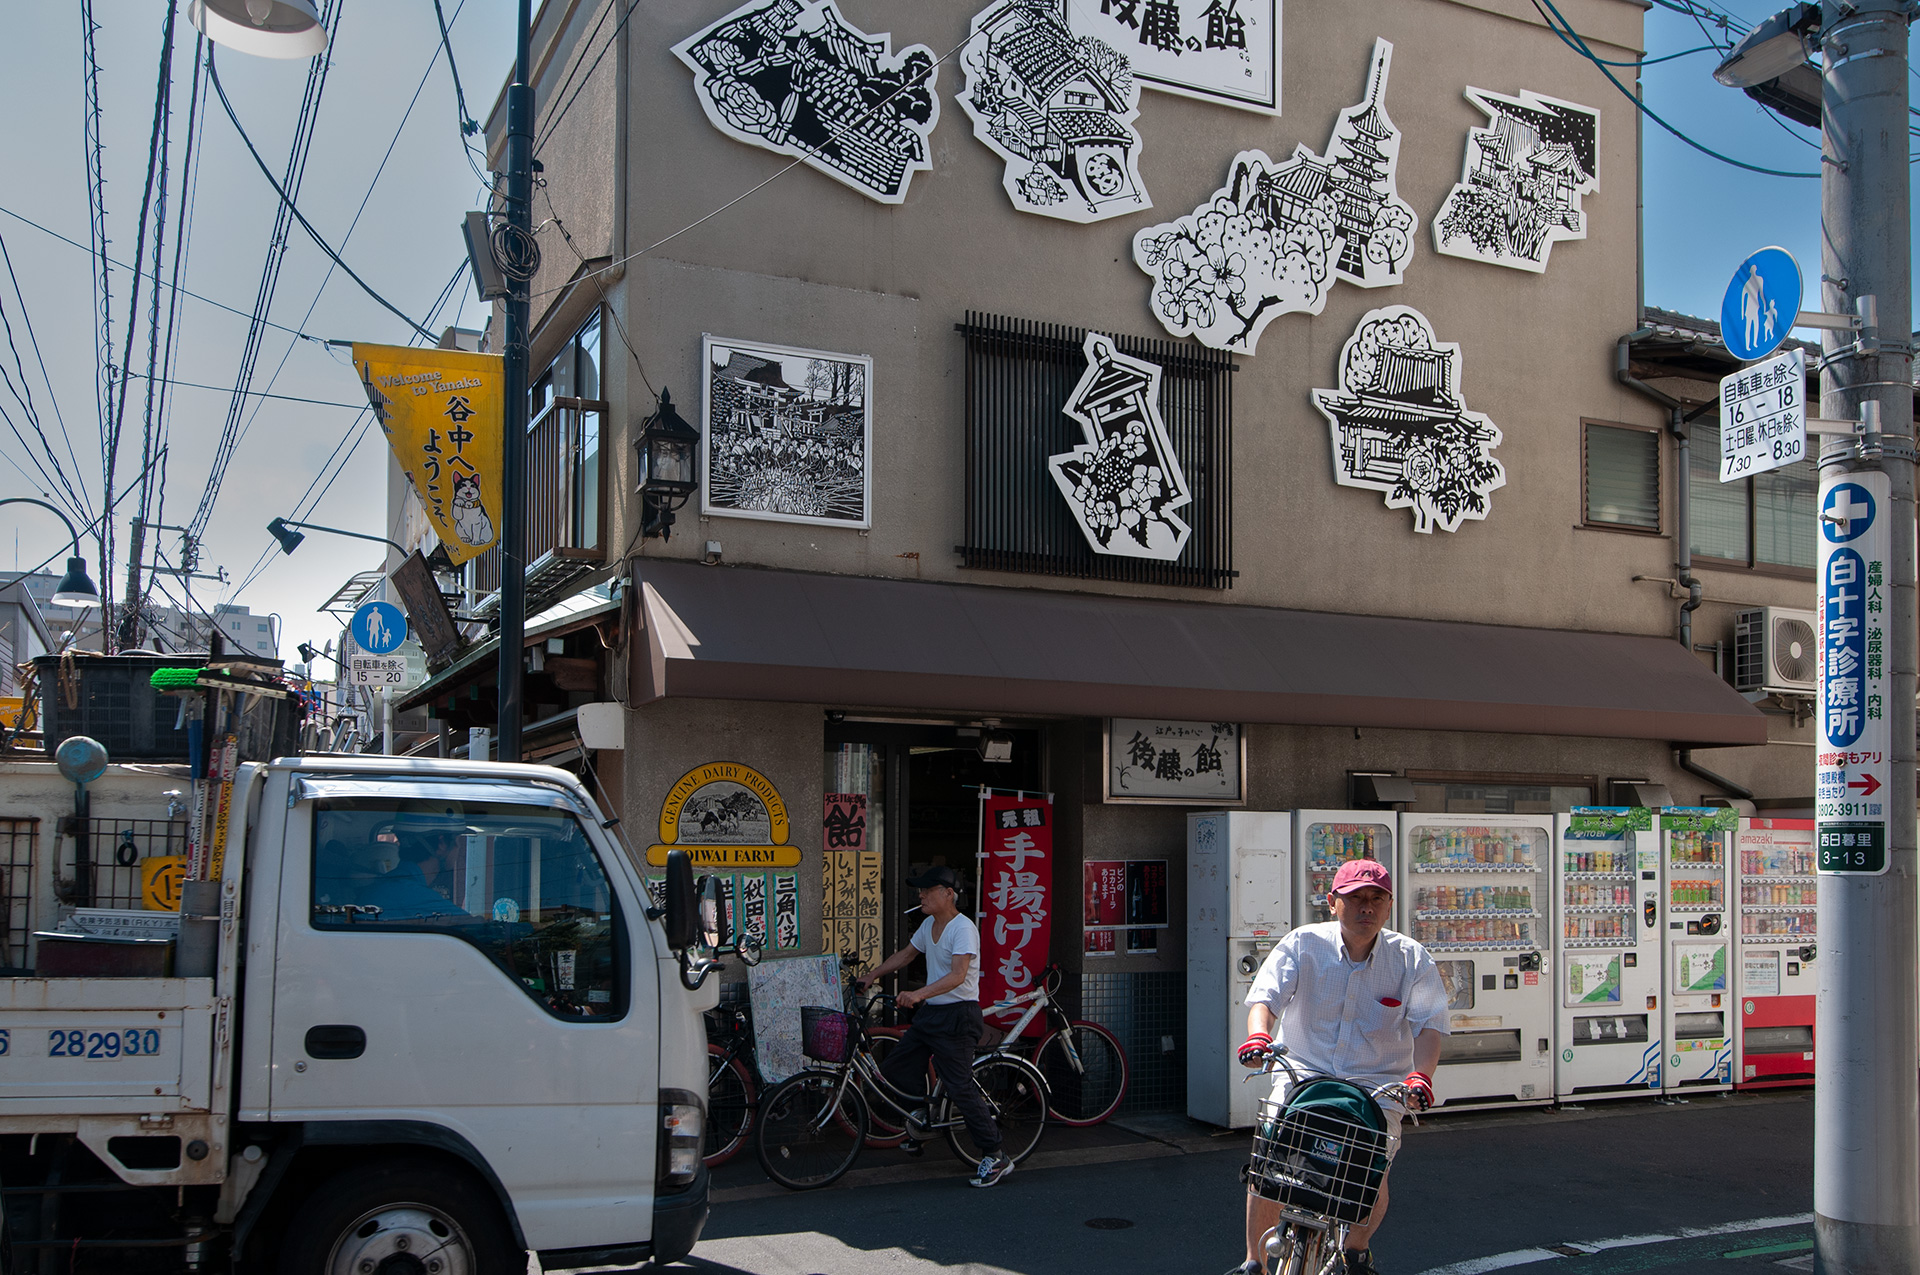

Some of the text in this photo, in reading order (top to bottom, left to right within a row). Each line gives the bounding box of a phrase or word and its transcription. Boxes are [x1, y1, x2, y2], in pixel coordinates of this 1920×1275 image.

[377, 370, 442, 388] Welcome
[411, 376, 482, 396] to Yanaka
[1725, 361, 1799, 403] 自転車を除く
[1729, 403, 1745, 426] 16
[1777, 385, 1794, 409] 18
[443, 395, 476, 472] 谷中へ
[1725, 454, 1752, 475] 7.30
[1772, 439, 1801, 461] 8.30
[422, 427, 449, 528] ようこそ
[1828, 555, 1860, 736] 白十字診療所
[353, 659, 404, 671] 自転車を除く
[356, 671, 368, 682] 15
[386, 671, 402, 683] 20
[1126, 730, 1222, 782] 後藤の飴
[664, 765, 786, 827] GENUINE DAIRY PRODUCTS
[823, 803, 866, 849] 飴
[1002, 809, 1041, 828] 元祖
[1334, 823, 1360, 833] KIRIN
[1466, 826, 1491, 836] KIRIN
[1740, 833, 1774, 845] amazaki
[1820, 832, 1872, 847] 西日暮里
[734, 849, 776, 863] FARM
[1823, 851, 1865, 865] 3-13
[835, 853, 857, 917] しょうが飴
[859, 856, 879, 917] ニッキ飴
[775, 876, 799, 949] 三角ハッカ
[988, 831, 1047, 1025] 手揚げもち
[49, 1029, 160, 1059] 282930
[1314, 1137, 1328, 1152] US
